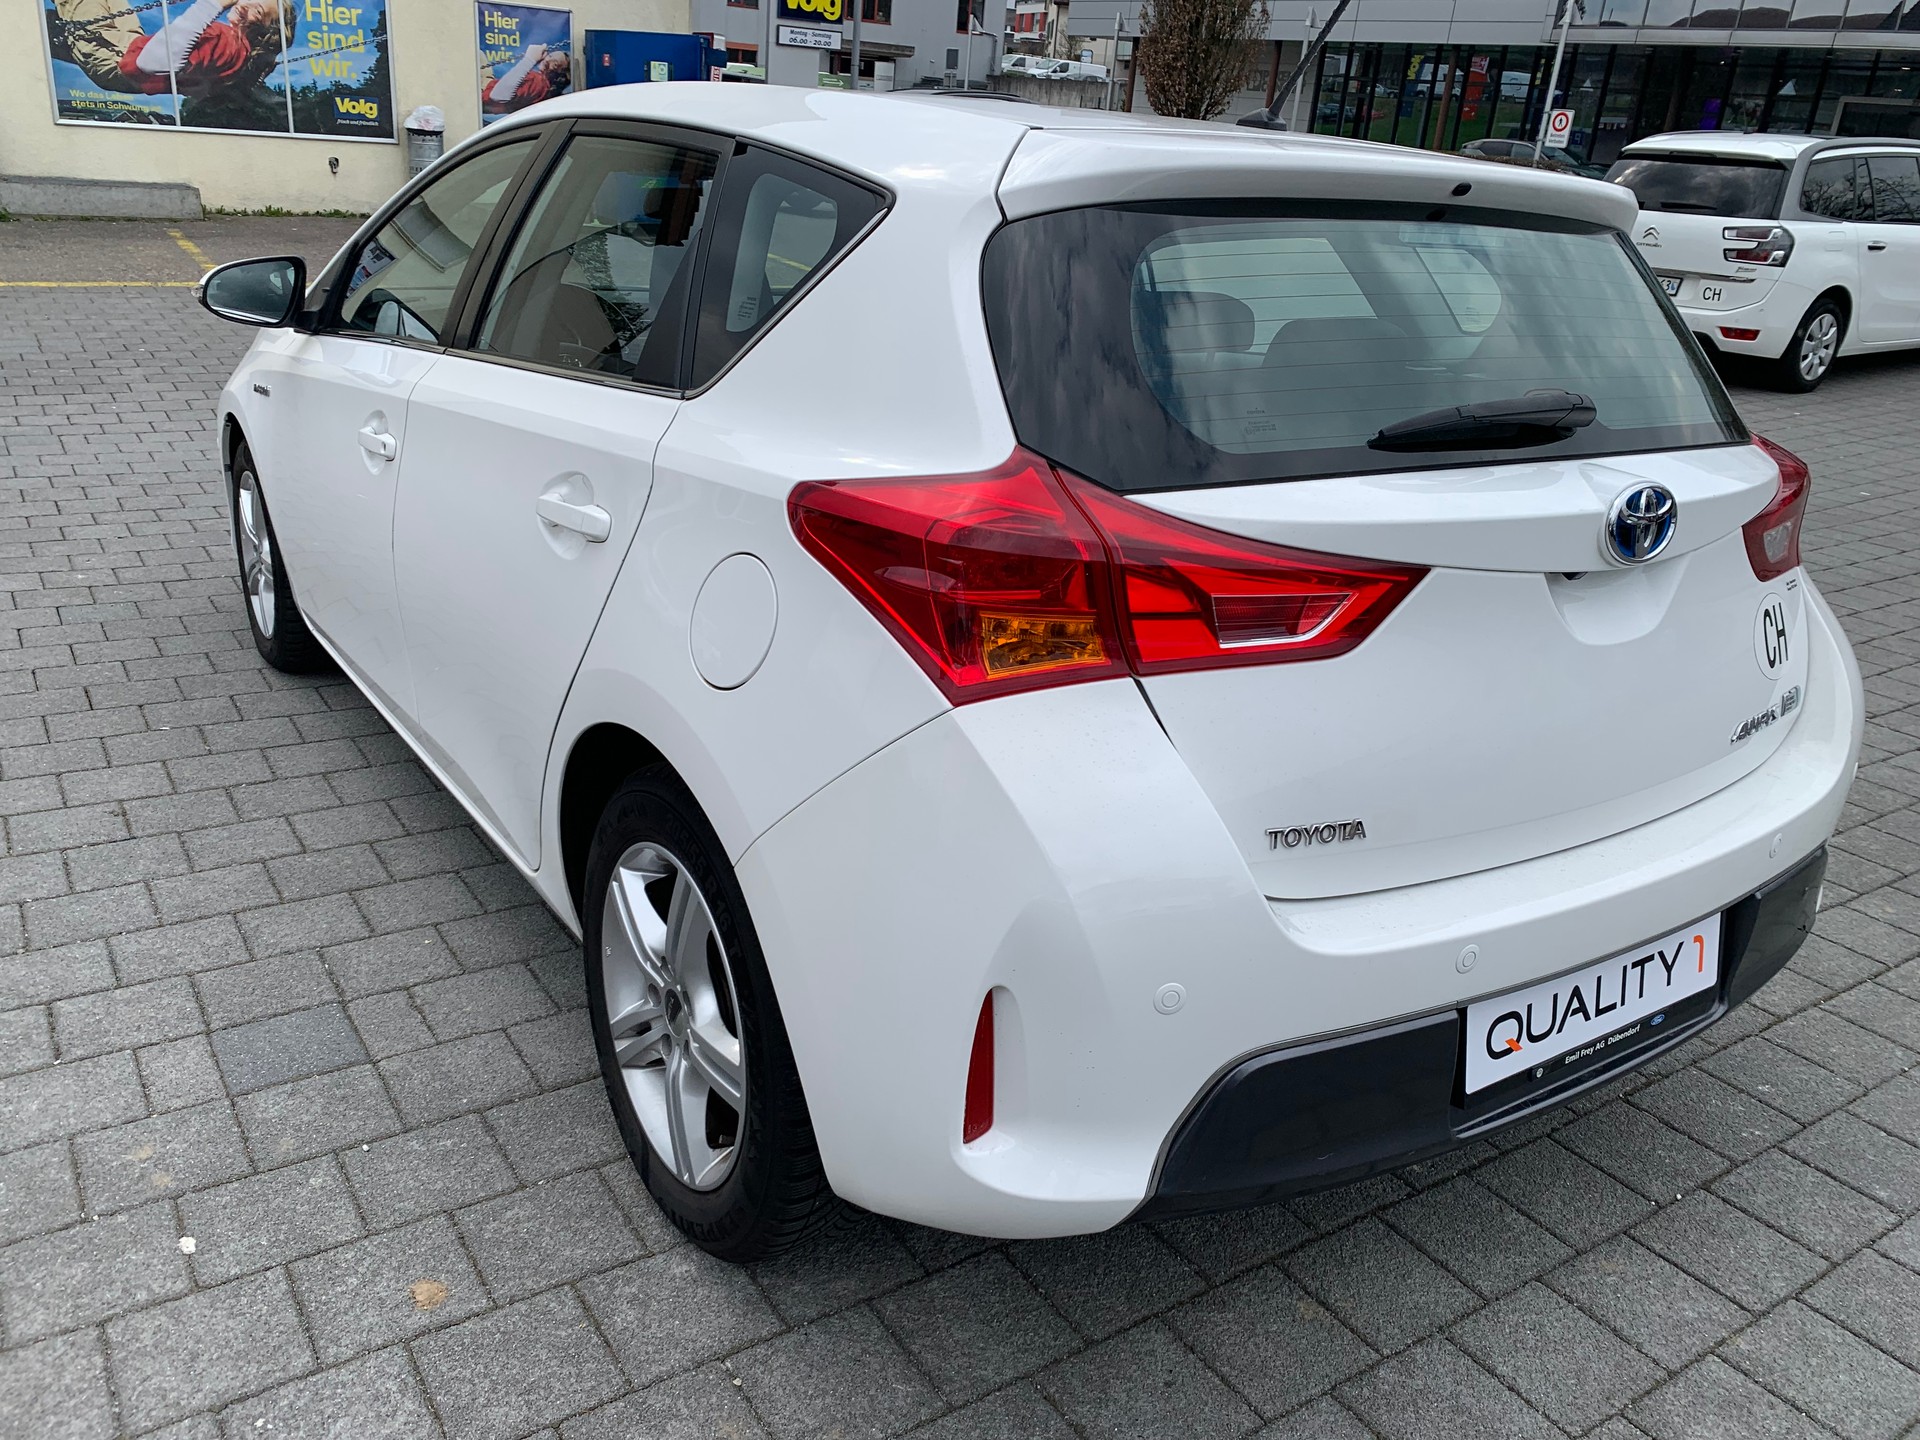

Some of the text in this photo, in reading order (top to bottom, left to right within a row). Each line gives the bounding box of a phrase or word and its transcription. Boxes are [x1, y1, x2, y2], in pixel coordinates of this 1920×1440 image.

[305, 0, 362, 25] Hier
[484, 10, 519, 29] Hier
[307, 25, 365, 53] sind
[485, 29, 520, 47] sind
[789, 36, 808, 44] 06.00
[813, 39, 832, 47] 20.00
[486, 46, 515, 63] wir.
[309, 53, 357, 79] wir.
[70, 89, 85, 98] Wo
[71, 99, 95, 108] stets
[106, 101, 149, 113] Schwung
[335, 97, 378, 118] Volg
[1703, 286, 1722, 301] CH
[1763, 602, 1789, 669] CH
[1265, 818, 1367, 850] TOYOTA
[1486, 934, 1704, 1060] QUALITY 1
[1565, 1024, 1641, 1064] Emil Frey AG Dübendorf
